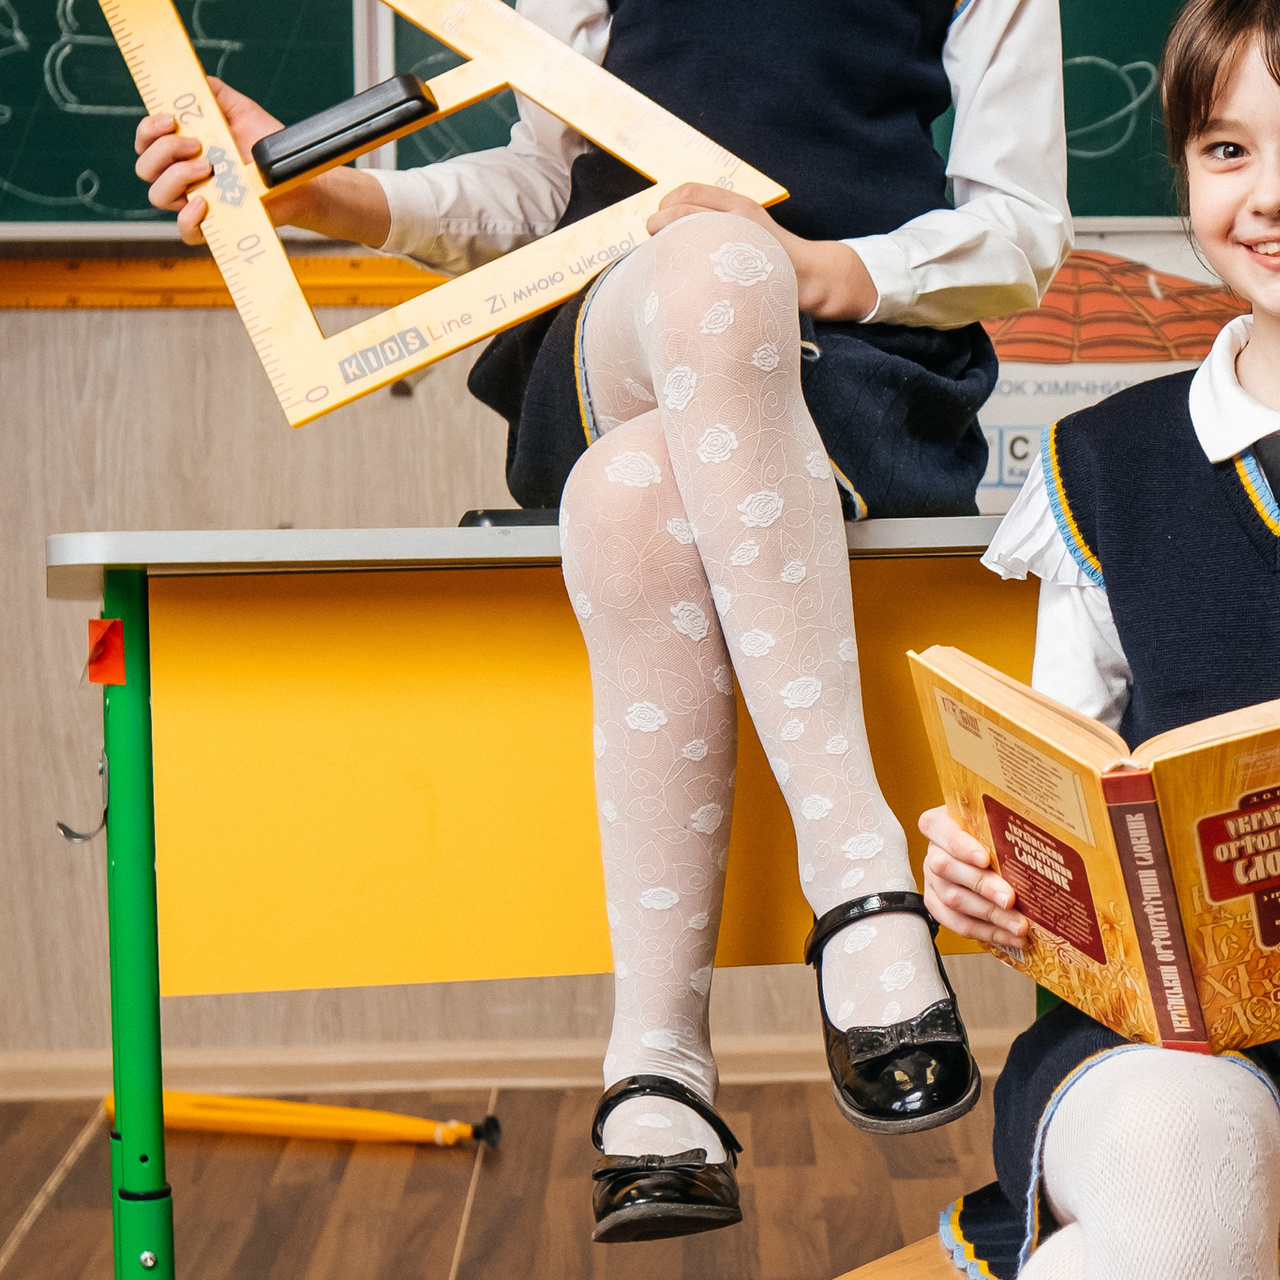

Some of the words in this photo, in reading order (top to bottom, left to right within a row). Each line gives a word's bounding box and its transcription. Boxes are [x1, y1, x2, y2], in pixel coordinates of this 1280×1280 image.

[173, 92, 205, 124] 20
[236, 234, 266, 265] 10
[512, 272, 566, 305] мною
[569, 233, 638, 277] цікаво!
[338, 326, 430, 385] KIDS
[426, 311, 473, 342] Line
[305, 385, 330, 403] 0
[1125, 813, 1155, 866] СЛОВНИК
